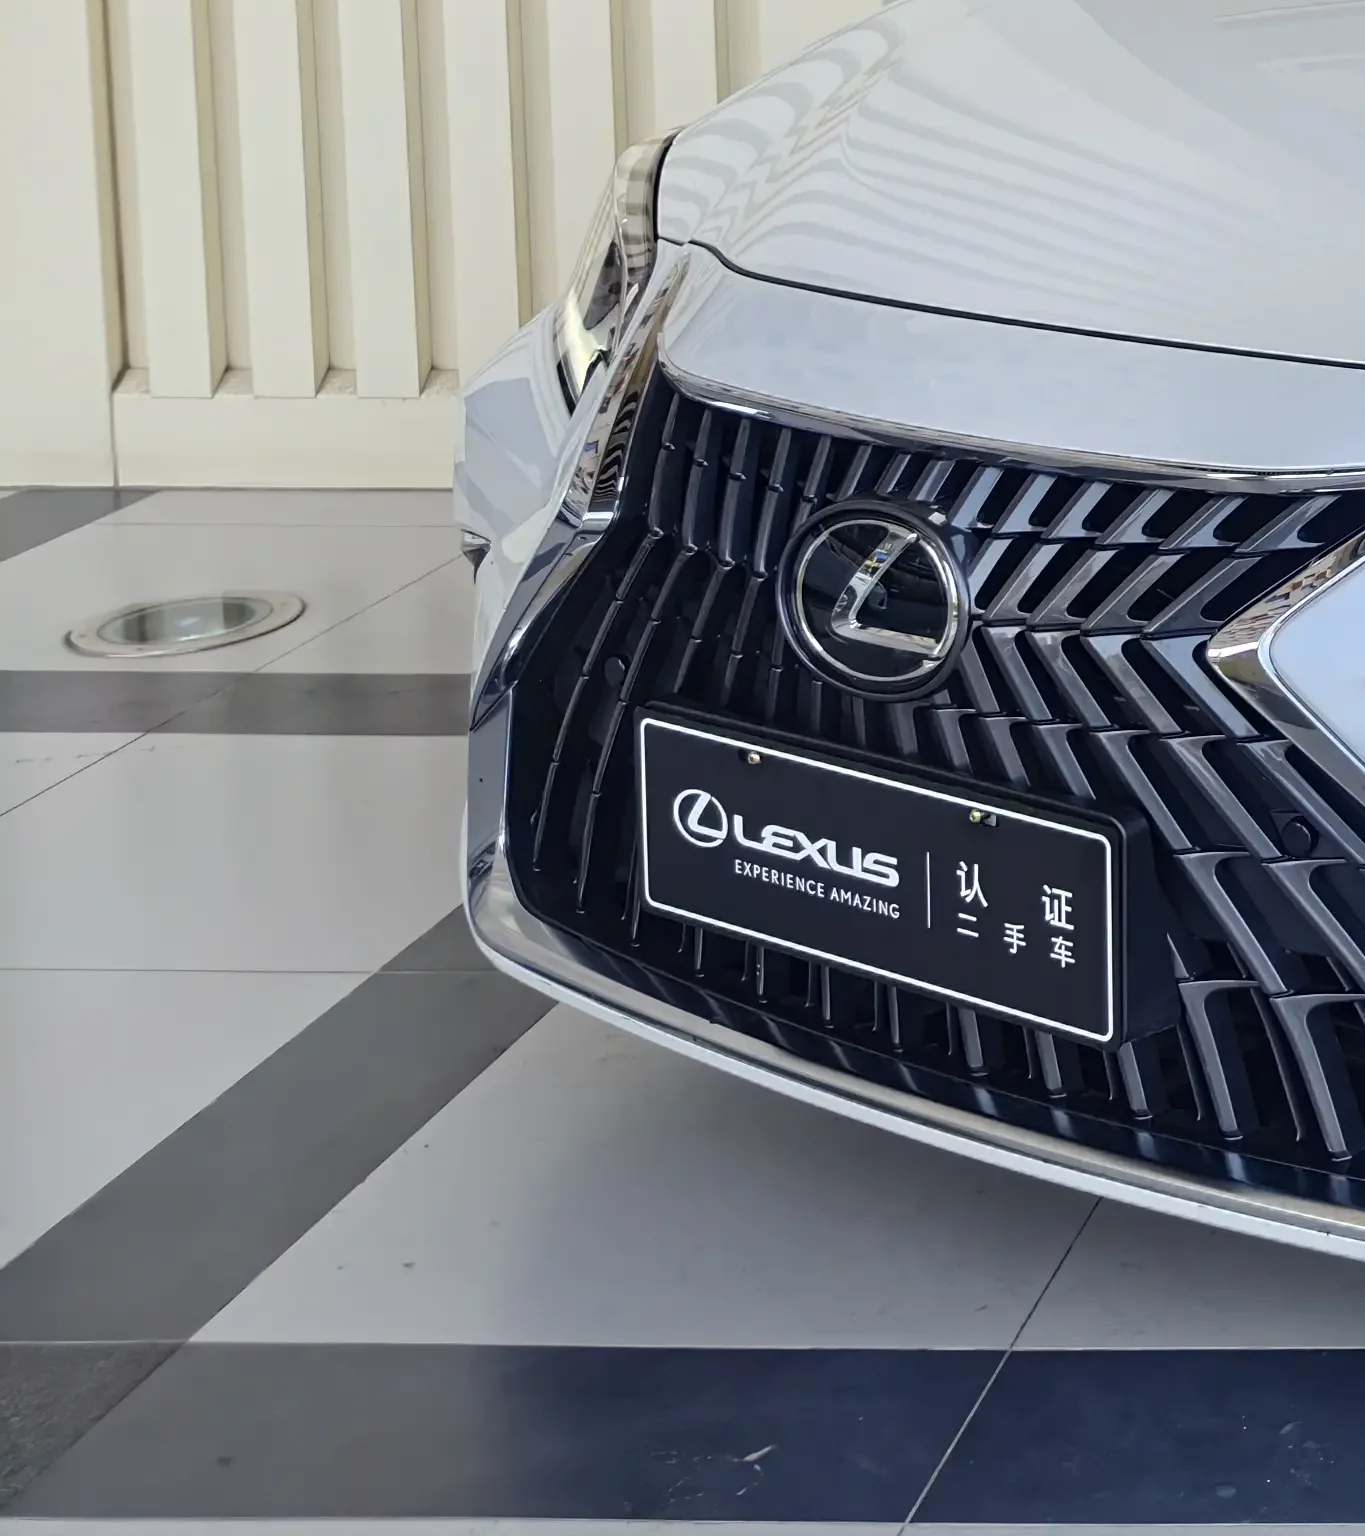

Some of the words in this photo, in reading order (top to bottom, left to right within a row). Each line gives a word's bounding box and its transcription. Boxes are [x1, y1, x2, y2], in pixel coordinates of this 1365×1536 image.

[733, 813, 900, 888] LEXUS
[734, 858, 825, 899] EXPERIENCE
[829, 886, 901, 920] AMAZING
[956, 860, 1075, 931] 认证
[956, 912, 1077, 969] 二手车
